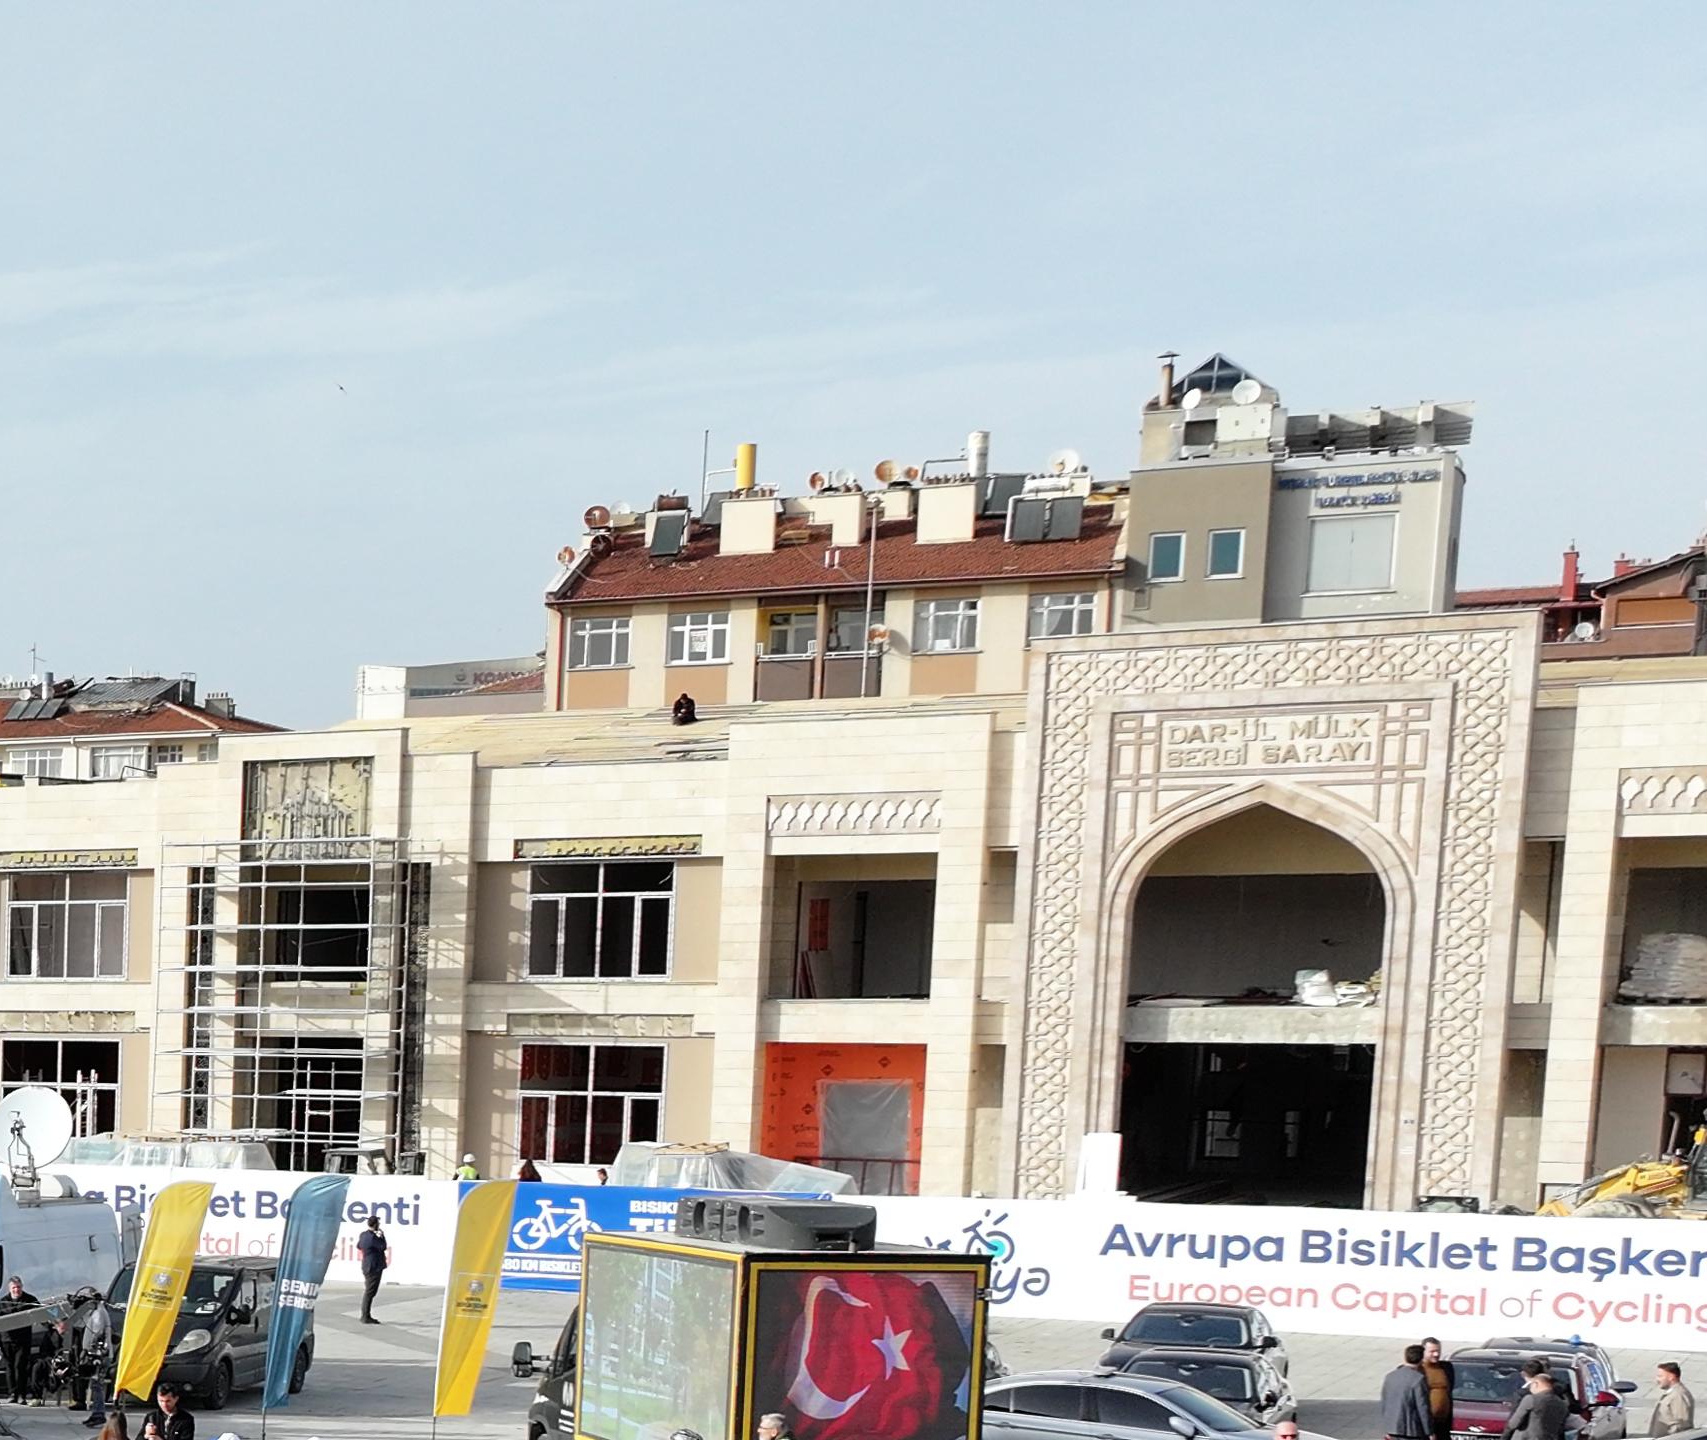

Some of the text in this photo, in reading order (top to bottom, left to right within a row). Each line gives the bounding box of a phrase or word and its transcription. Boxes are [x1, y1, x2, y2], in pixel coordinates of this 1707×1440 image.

[1168, 716, 1370, 745] DAR-ÜL MÜLK
[1167, 742, 1371, 768] SERGİ SARAYI
[114, 1184, 420, 1227] Biet Baenti
[629, 1200, 677, 1214] BİSİK
[247, 1232, 275, 1257] of
[1099, 1223, 1707, 1283] Avrupa Bisiklet Başken
[521, 1259, 537, 1270] KM
[1128, 1274, 1318, 1309] European
[1330, 1283, 1487, 1318] Capital
[1499, 1288, 1543, 1318] of
